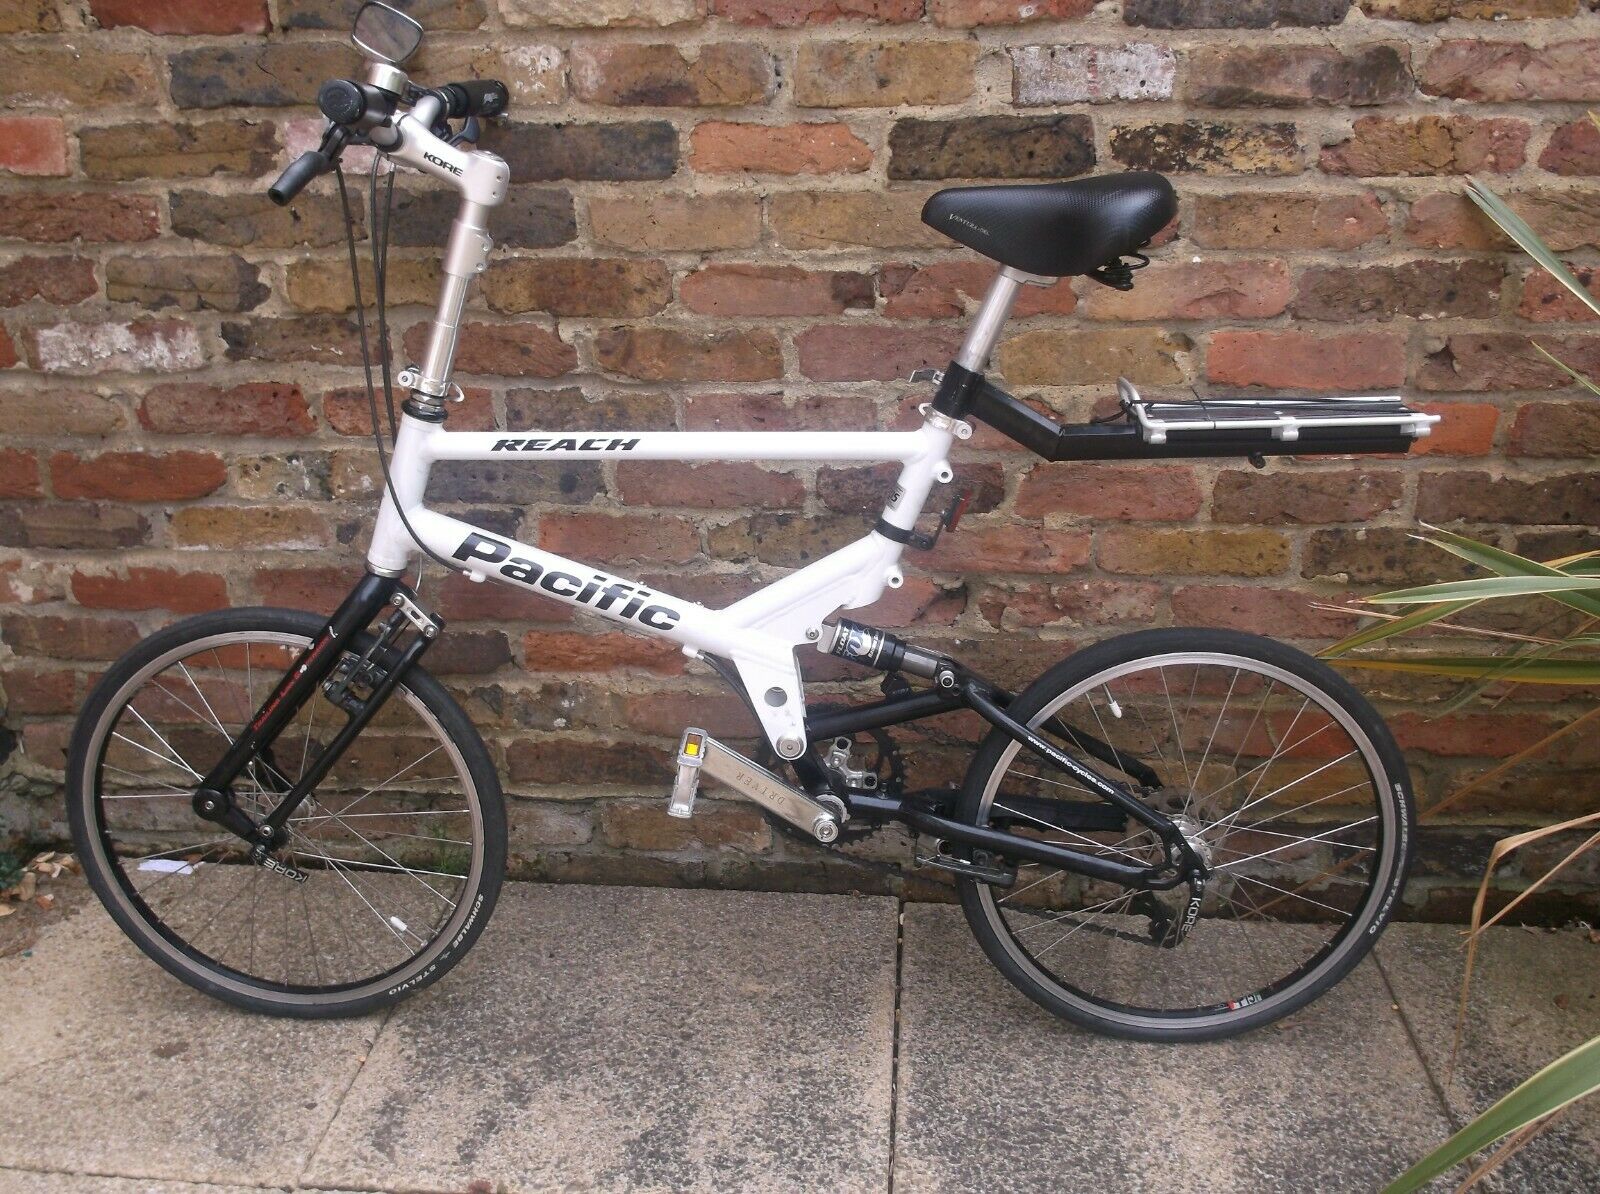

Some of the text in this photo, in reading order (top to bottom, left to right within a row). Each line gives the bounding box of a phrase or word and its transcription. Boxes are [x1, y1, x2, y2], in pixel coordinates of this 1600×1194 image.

[423, 151, 464, 178] KORE
[490, 438, 642, 452] REACH
[452, 532, 681, 631] Pacific
[1027, 735, 1116, 796] www.pacific-cycles.com
[735, 771, 786, 805] DRIVER
[263, 857, 308, 882] KORE
[1181, 897, 1202, 932] KORE
[1369, 878, 1399, 934] STELVIO
[388, 893, 484, 996] SCHWALBE STELVIO
